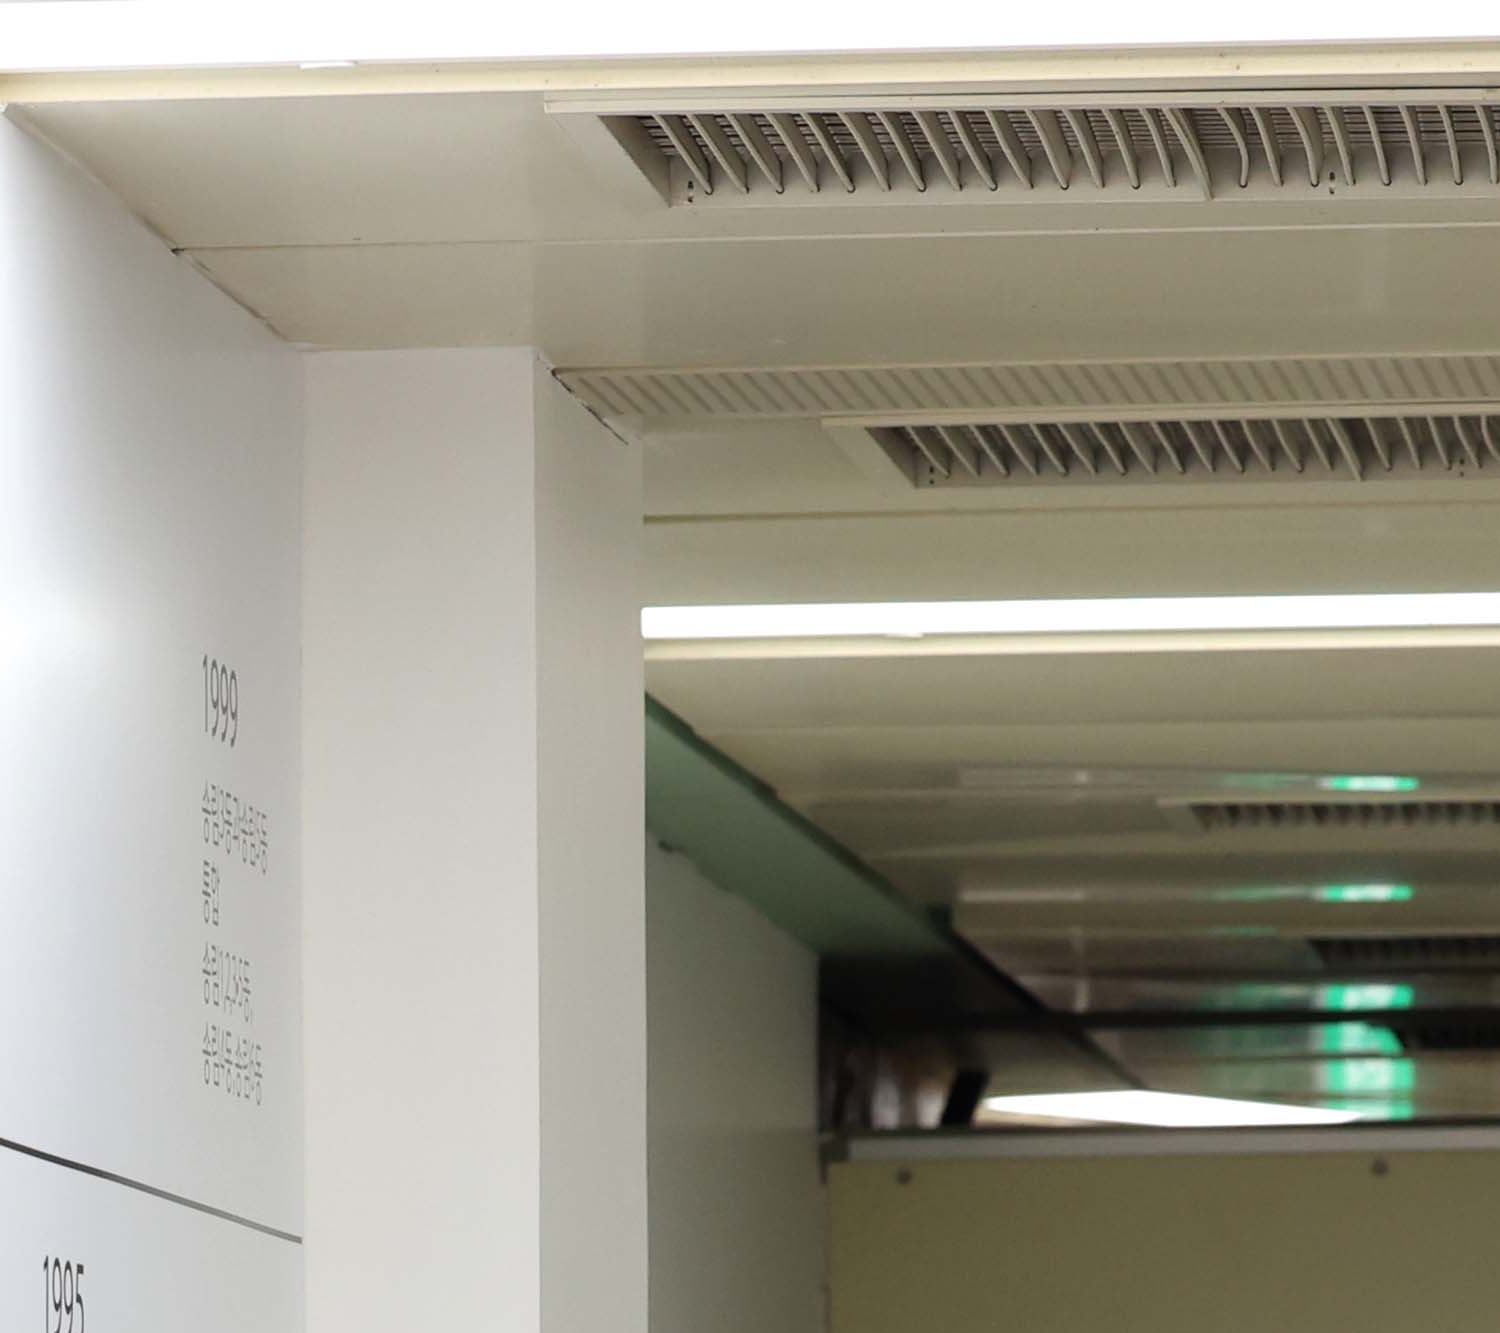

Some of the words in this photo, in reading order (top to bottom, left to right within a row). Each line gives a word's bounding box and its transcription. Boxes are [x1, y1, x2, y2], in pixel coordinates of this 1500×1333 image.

[202, 654, 239, 748] 1999
[201, 782, 240, 855] 송림3동과
[239, 797, 269, 876] 송림5동
[201, 859, 221, 927] 통합
